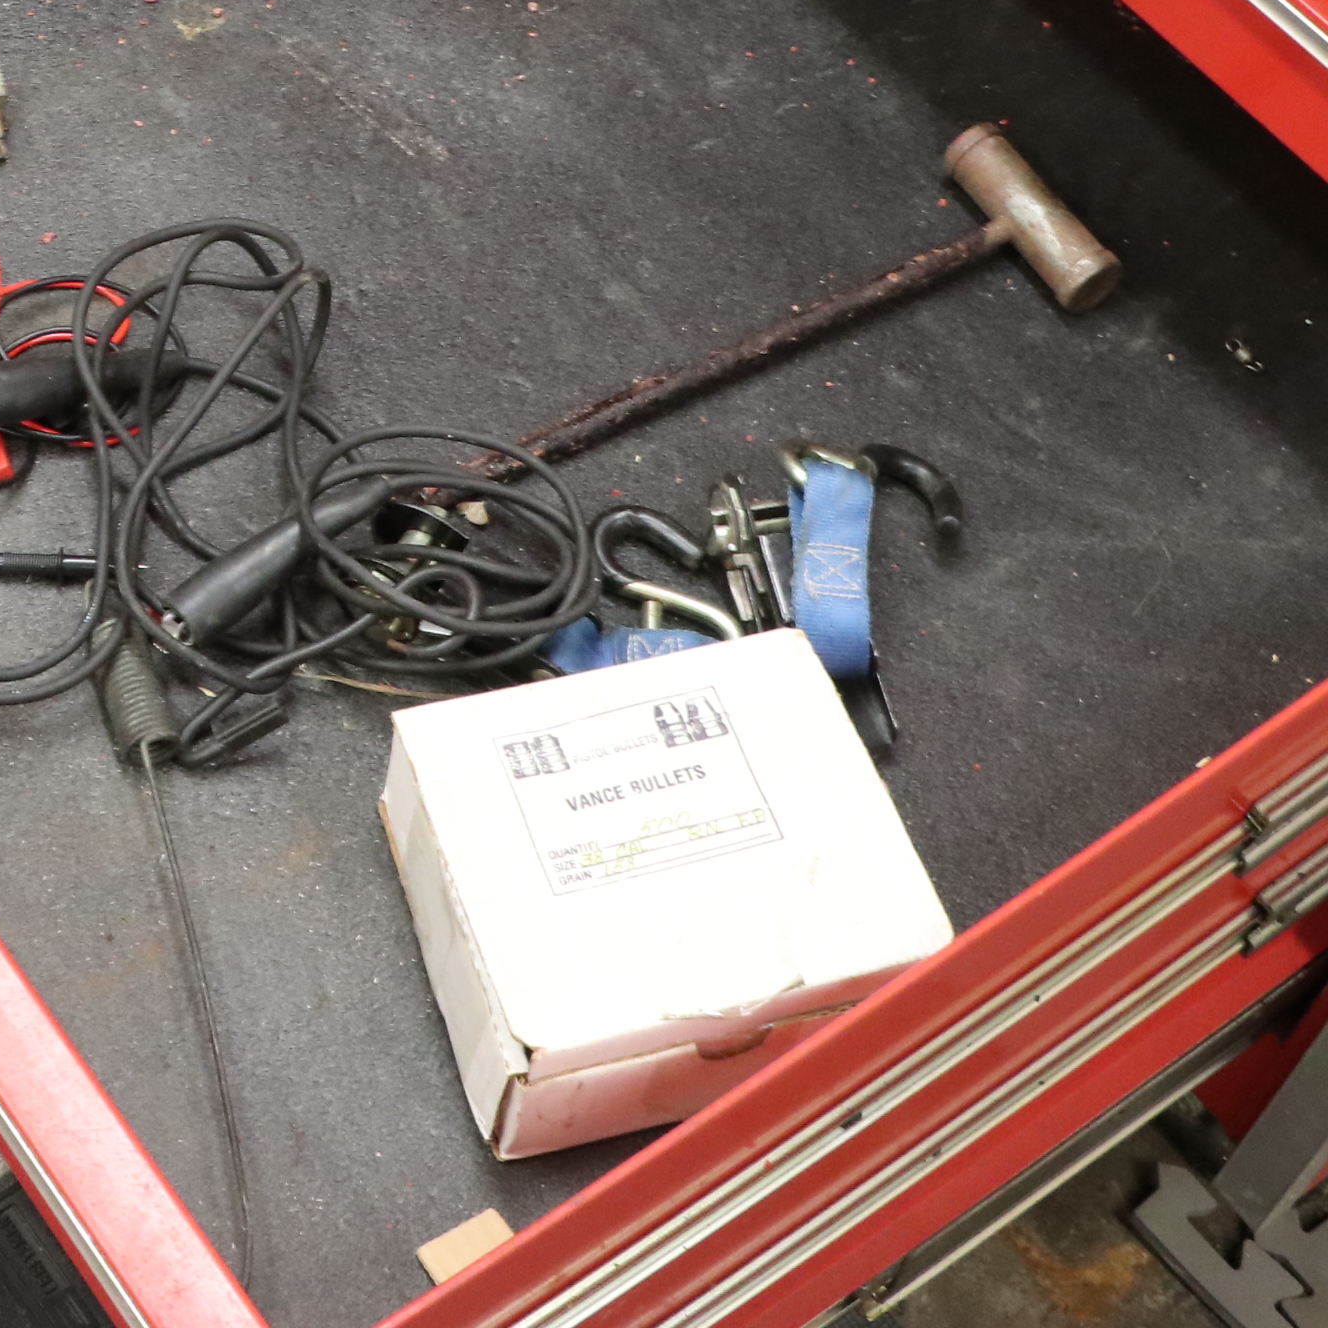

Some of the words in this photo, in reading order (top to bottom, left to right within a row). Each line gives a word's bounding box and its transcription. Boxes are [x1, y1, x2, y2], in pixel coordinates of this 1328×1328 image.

[611, 733, 659, 753] BULLETS
[565, 784, 626, 812] VANCE
[629, 763, 707, 795] BULLETS
[548, 840, 601, 860] QUANTITY
[576, 849, 605, 867] 38
[553, 858, 577, 873] SIZE
[558, 869, 593, 886] GRAIN
